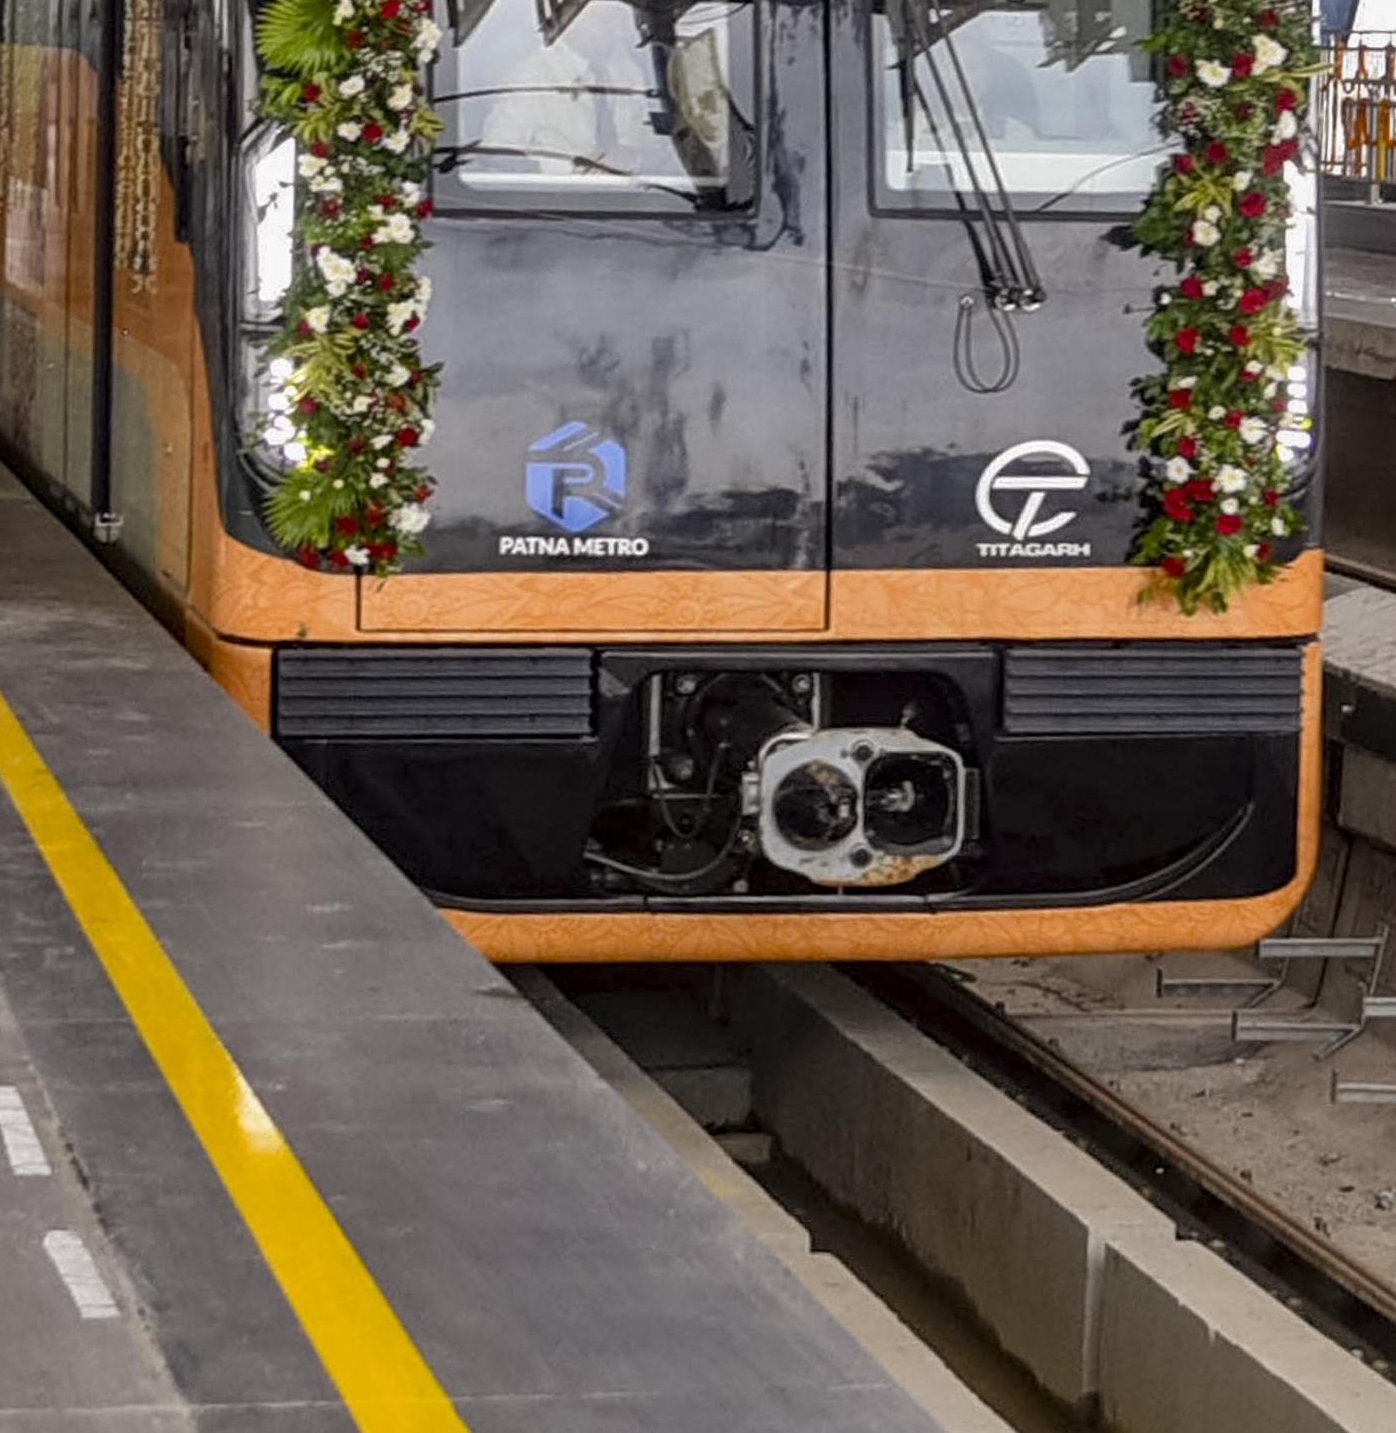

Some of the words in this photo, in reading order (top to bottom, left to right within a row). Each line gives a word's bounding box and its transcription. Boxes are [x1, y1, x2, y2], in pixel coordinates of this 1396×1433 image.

[498, 535, 570, 556] PATNA
[573, 536, 650, 557] METRO
[975, 542, 1091, 557] TITAGARH
